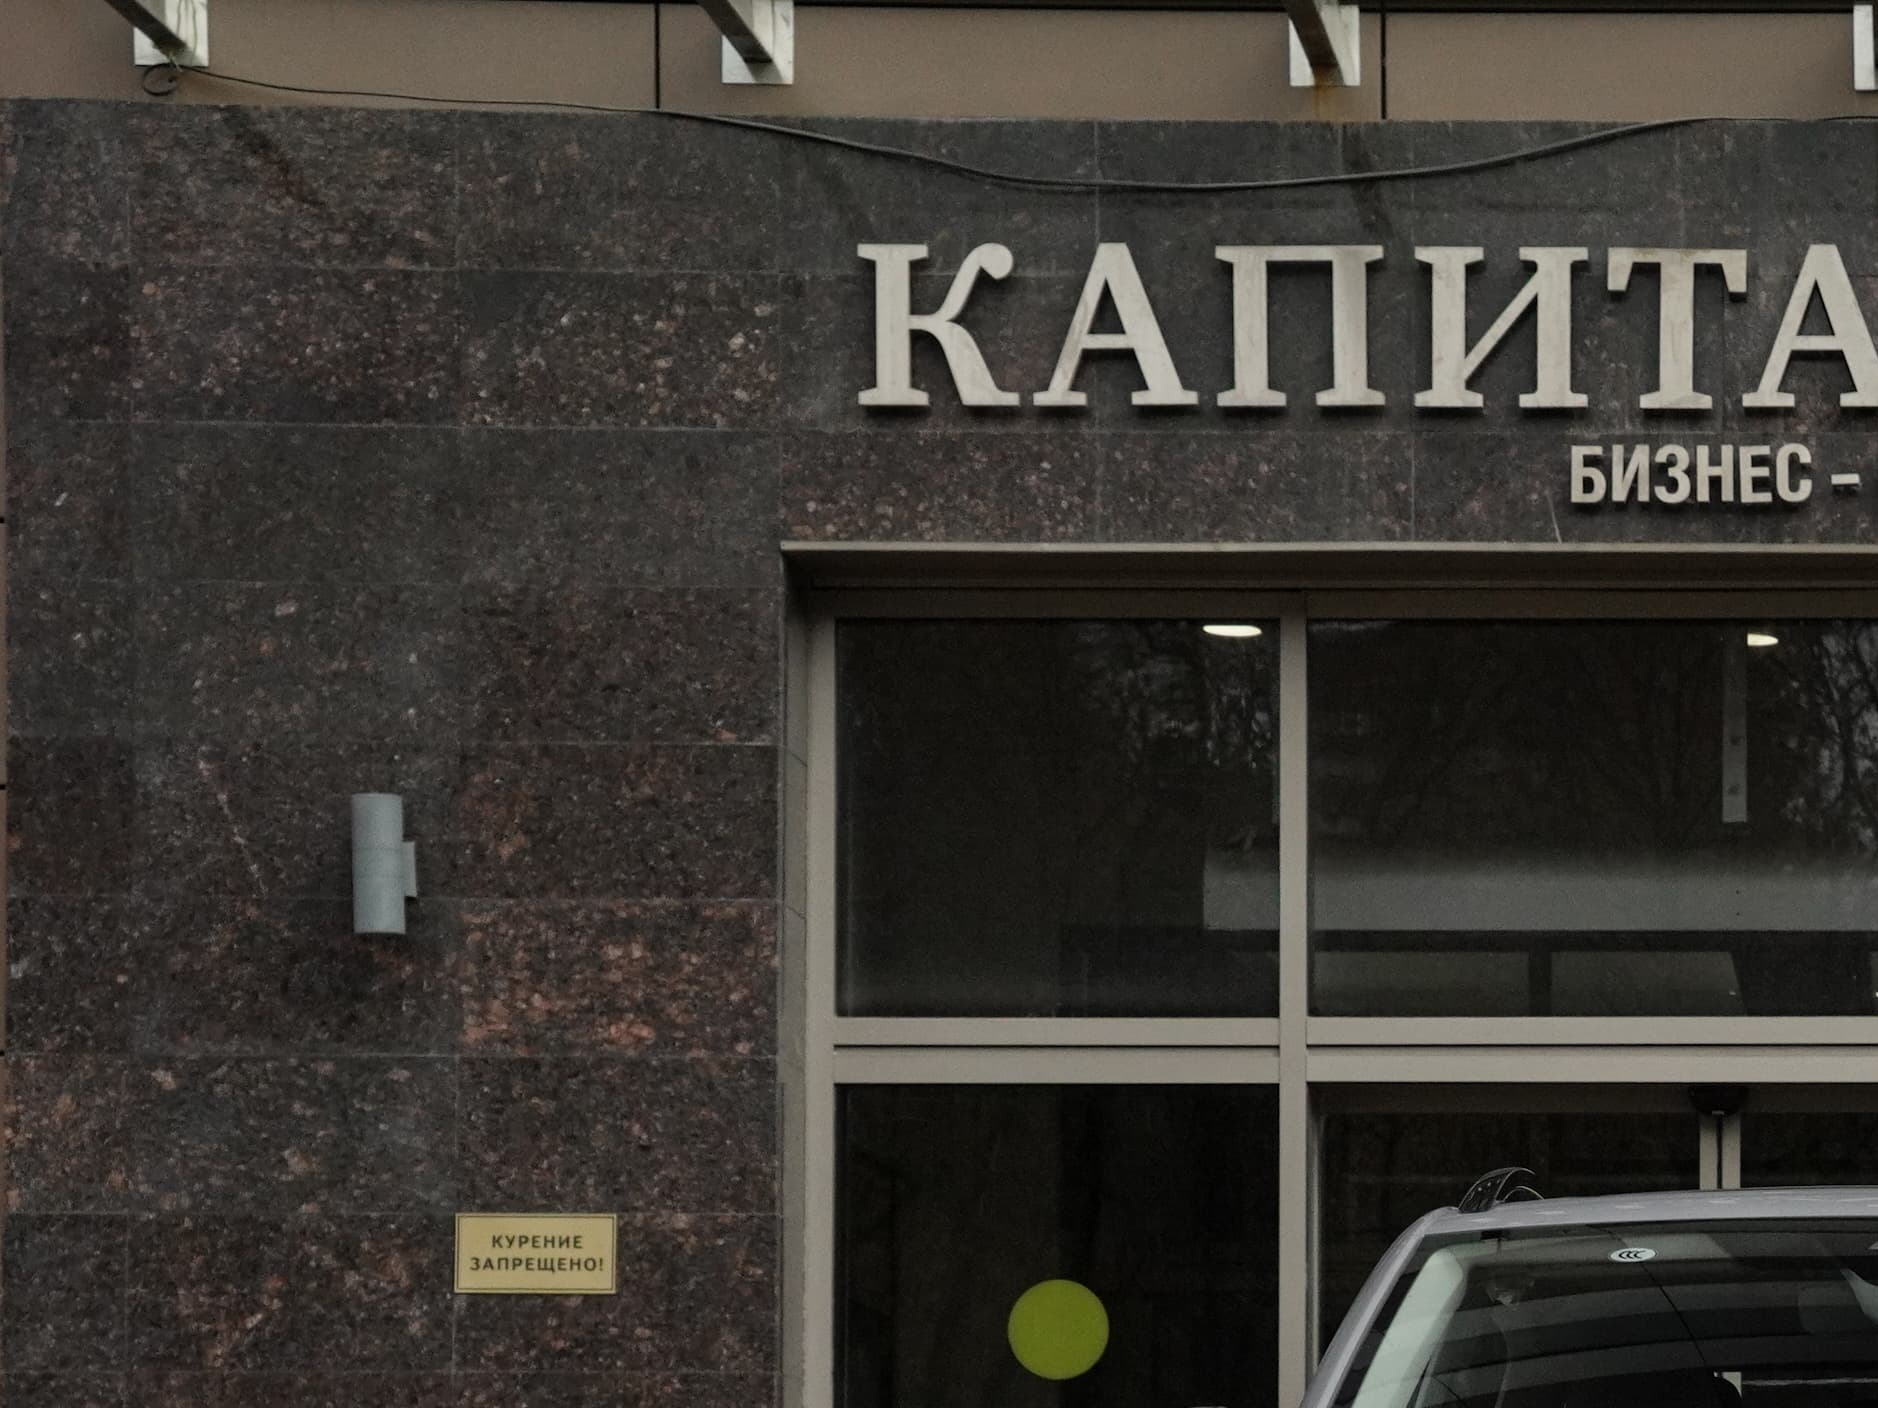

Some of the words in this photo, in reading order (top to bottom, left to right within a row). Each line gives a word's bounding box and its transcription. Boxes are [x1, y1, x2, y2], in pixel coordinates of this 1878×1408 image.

[1567, 444, 1815, 507] БИЗНЕС
[491, 1234, 584, 1249] КУРЕНИЕ
[469, 1256, 604, 1273] ЗАПРЕЩЕНО!
